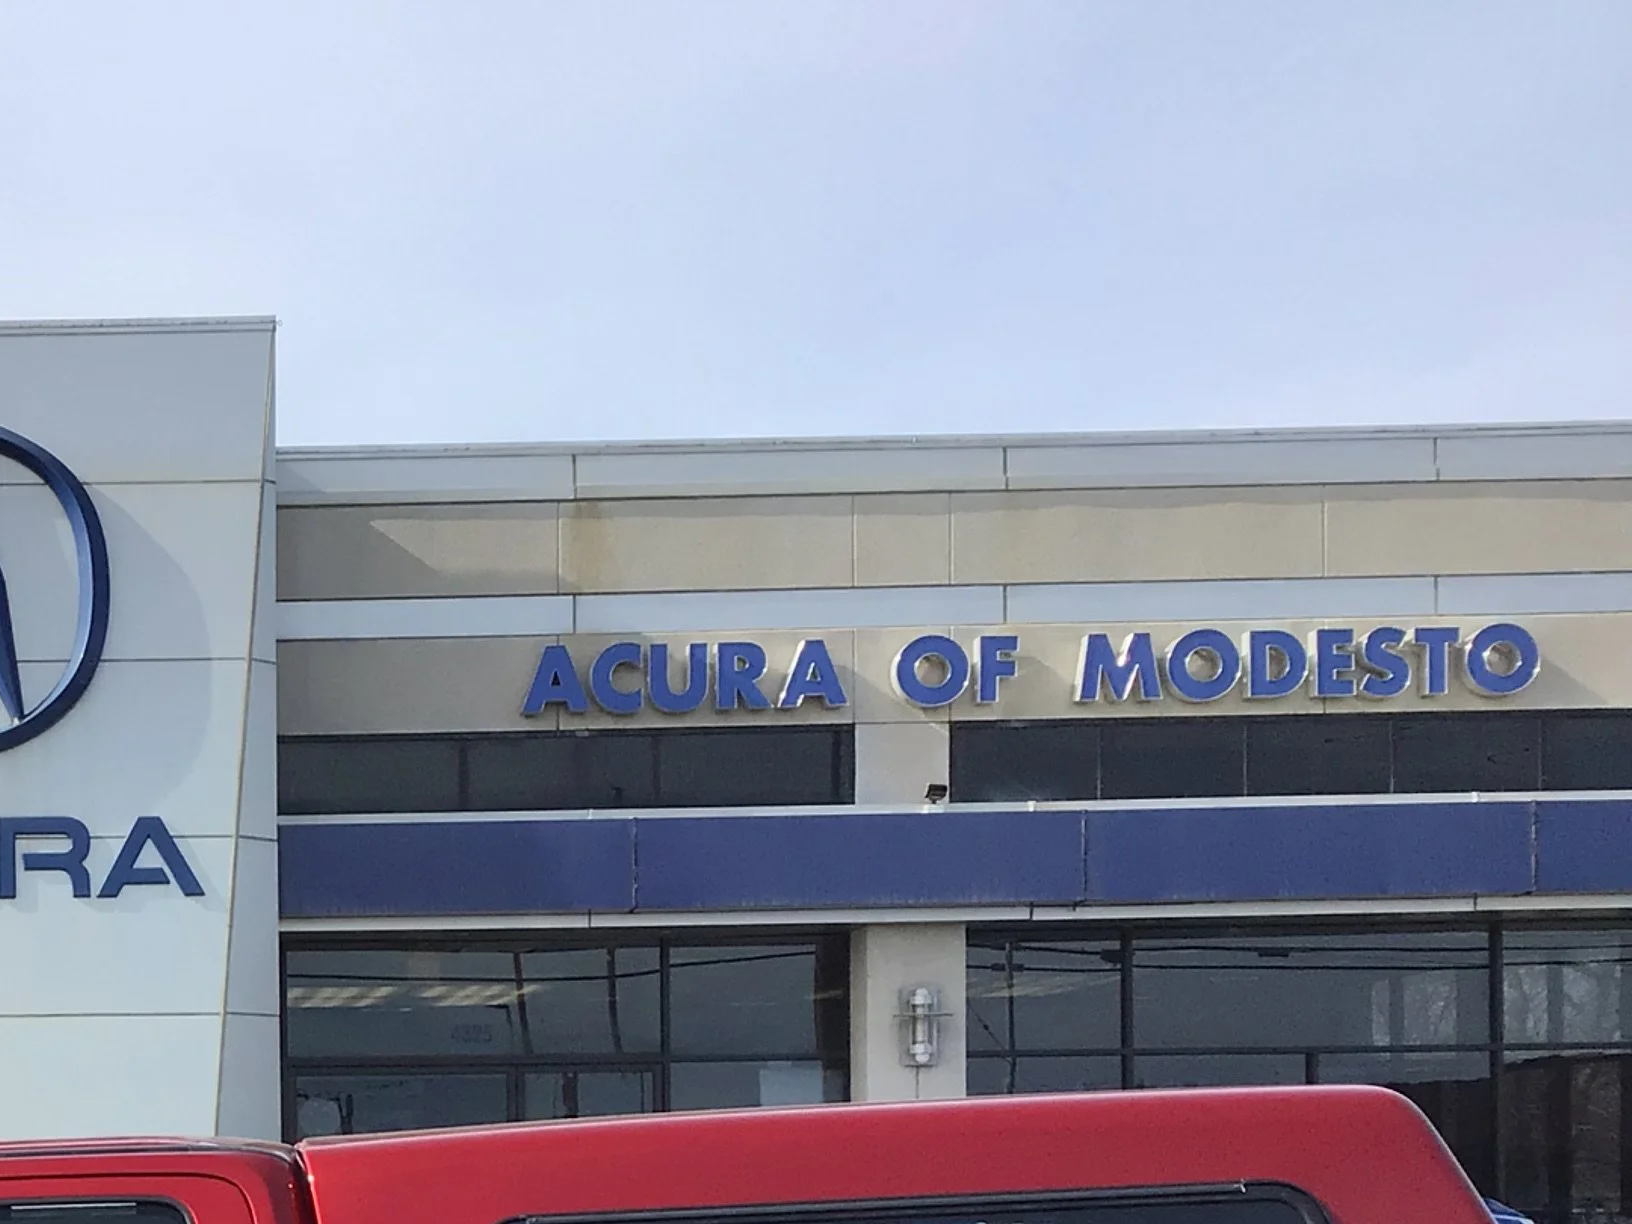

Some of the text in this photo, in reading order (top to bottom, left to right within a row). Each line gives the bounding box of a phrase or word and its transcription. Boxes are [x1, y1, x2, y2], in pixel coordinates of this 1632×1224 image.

[520, 623, 1541, 717] ACURA OF MODESTO
